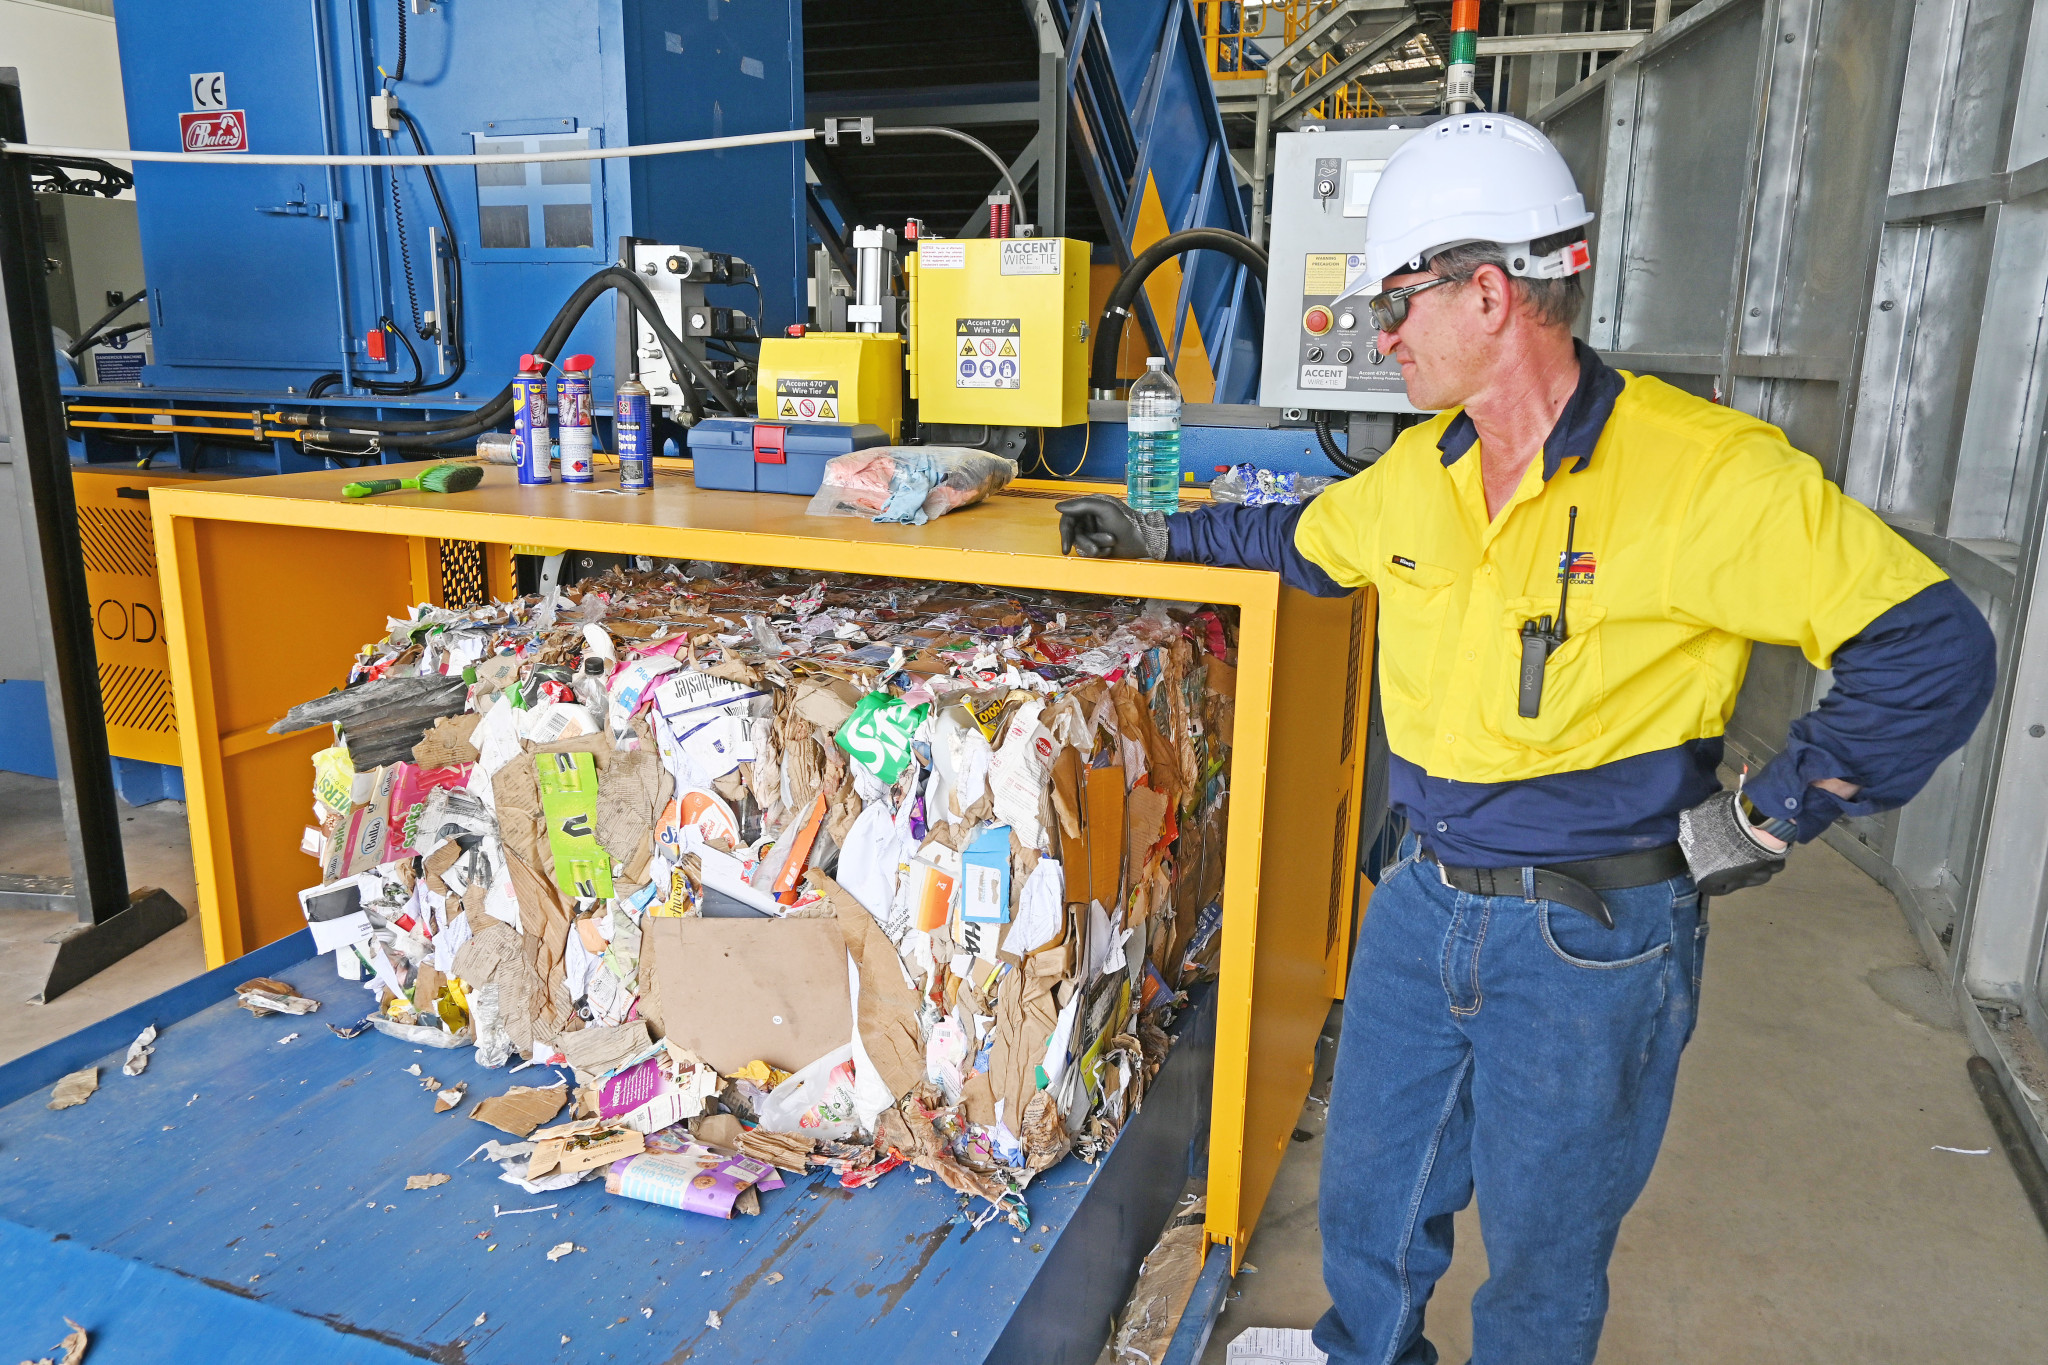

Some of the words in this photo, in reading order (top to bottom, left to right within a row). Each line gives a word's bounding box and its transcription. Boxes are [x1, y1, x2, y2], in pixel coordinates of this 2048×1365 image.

[1004, 242, 1057, 254] ACCENT
[973, 326, 990, 334] Wire
[991, 326, 1006, 334] Tier
[1304, 369, 1344, 378] ACCENT
[808, 387, 823, 395] Tier
[979, 700, 1001, 722] SOLO
[365, 820, 381, 853] Bulla
[630, 1164, 656, 1179] chip
[642, 1158, 687, 1176] cookies
[656, 1172, 684, 1187] choc
